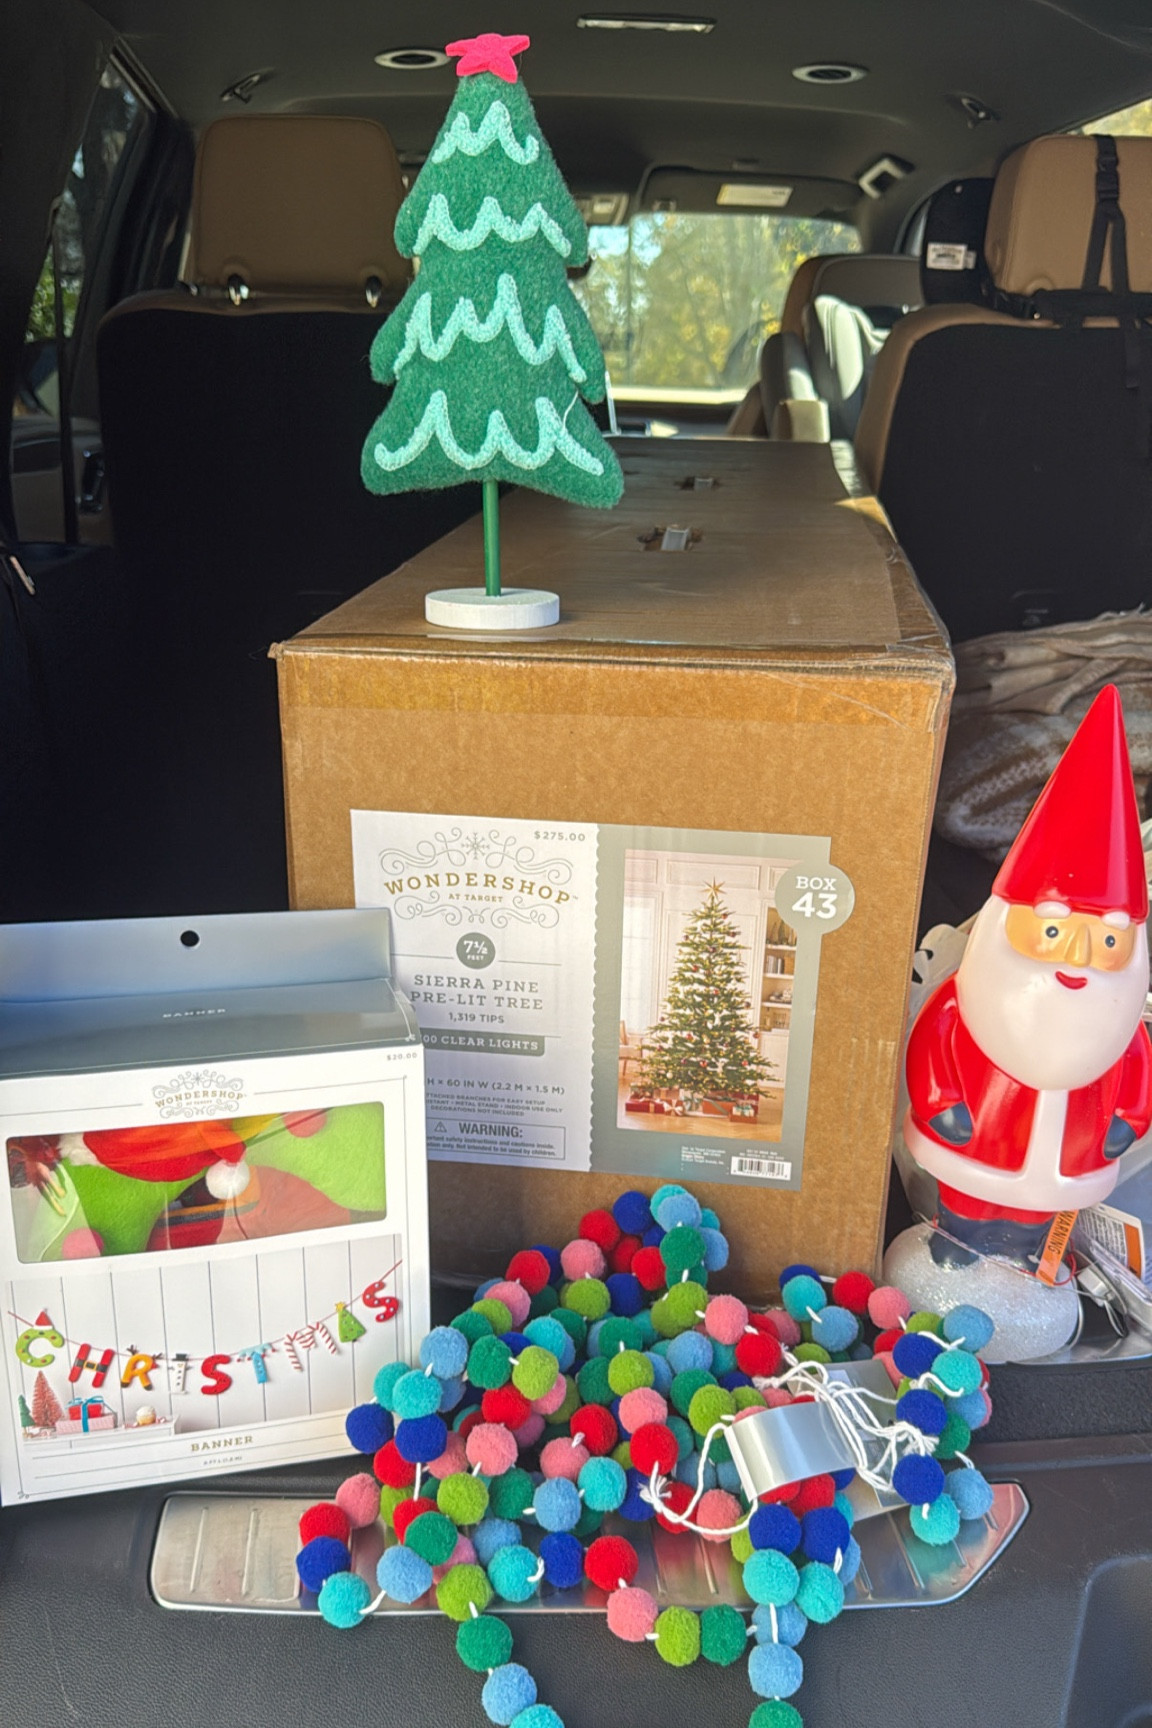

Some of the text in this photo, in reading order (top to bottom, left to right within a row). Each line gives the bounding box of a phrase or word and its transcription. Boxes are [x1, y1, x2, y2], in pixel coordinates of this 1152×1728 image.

[534, 831, 586, 842] $275.00
[384, 872, 571, 905] WONDERSHOP
[796, 876, 837, 892] BOX
[464, 894, 504, 903] TARGET
[791, 893, 838, 919] 43
[414, 974, 539, 993] SIERRA PINE
[410, 991, 543, 1010] PRE-LIT TREE
[449, 1012, 505, 1024] 1,319 TIPS
[420, 1034, 539, 1051] 00 CLEAR LIGHTS
[447, 1079, 461, 1087] 60
[463, 1080, 475, 1088] IN
[478, 1081, 489, 1089] W
[492, 1082, 511, 1091] (2.2
[514, 1083, 523, 1091] M
[536, 1085, 549, 1093] 1.5
[551, 1086, 565, 1095] M)
[155, 1090, 244, 1107] WONDERSHOP
[459, 1122, 523, 1138] WARNING:
[191, 1435, 254, 1452] BANNER
